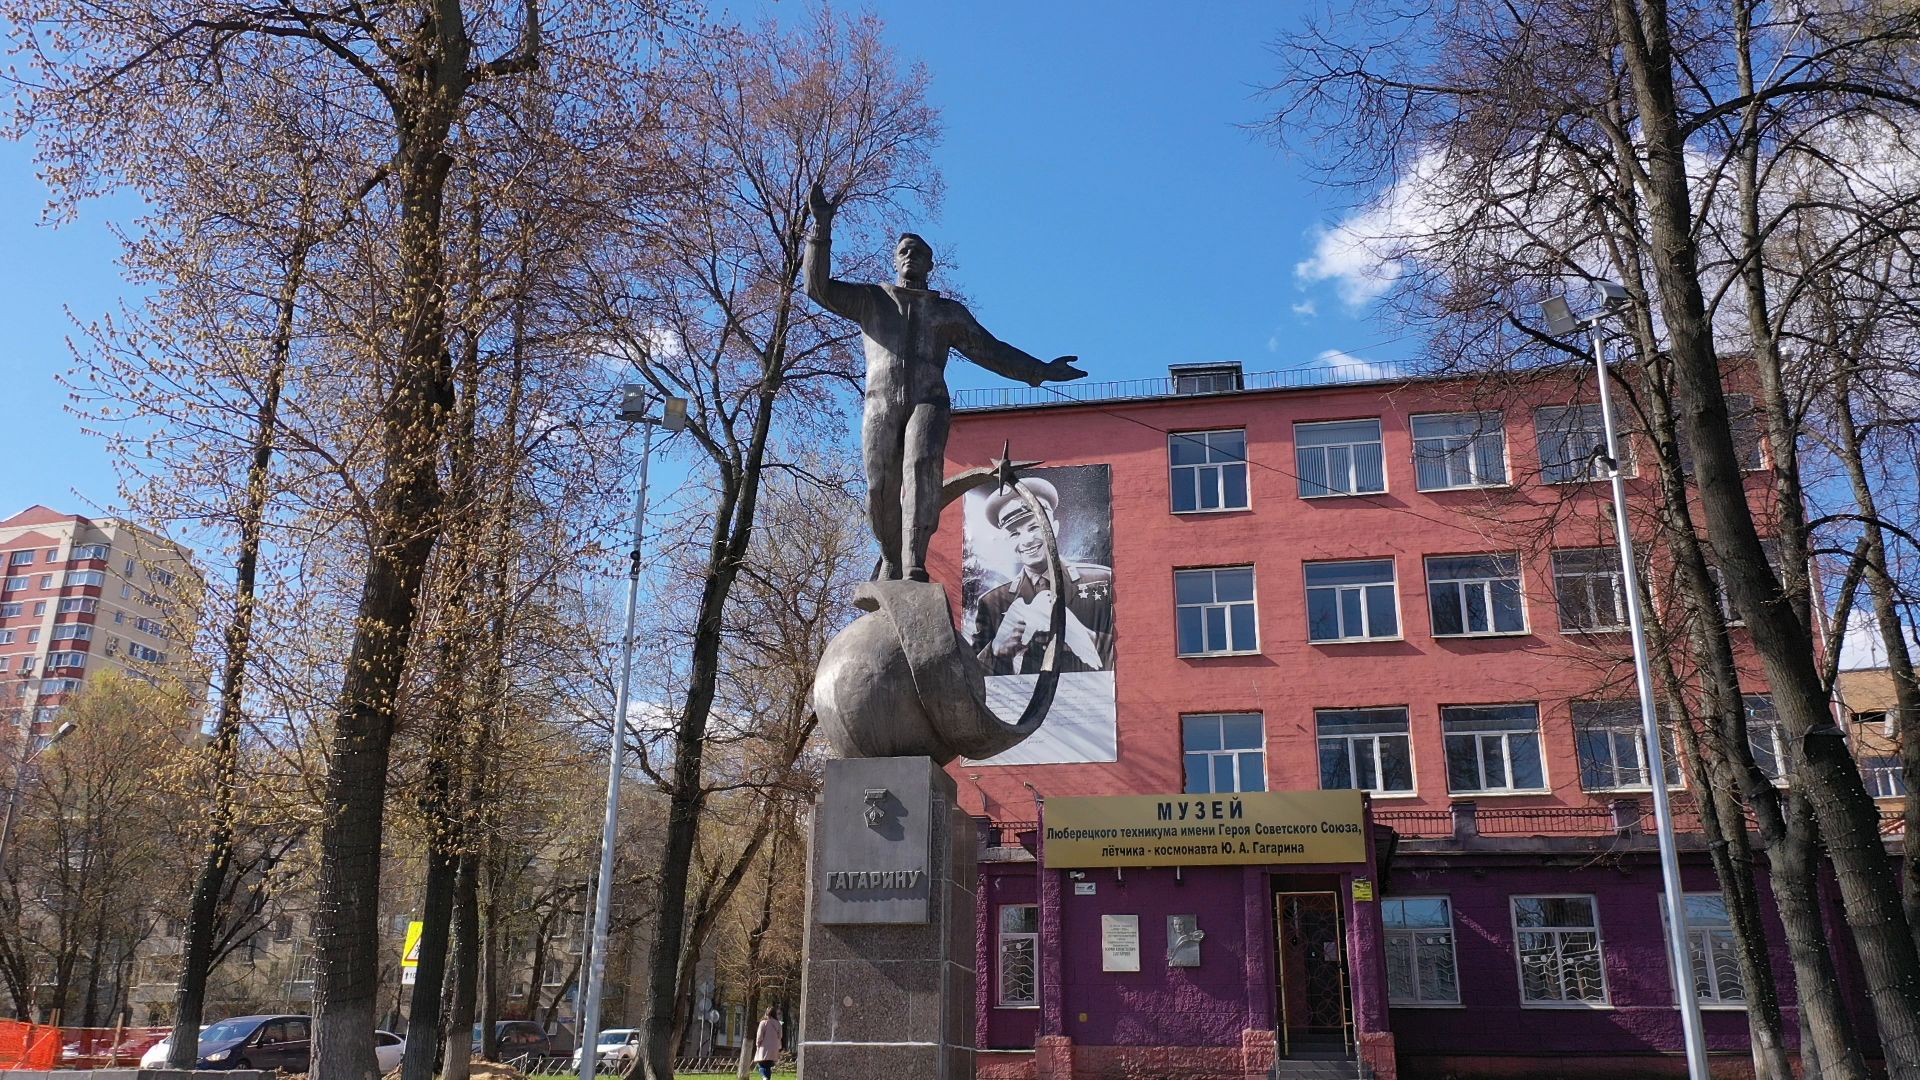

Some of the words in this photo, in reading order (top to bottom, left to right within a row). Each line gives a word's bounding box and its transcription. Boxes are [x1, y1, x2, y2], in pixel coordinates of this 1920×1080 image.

[1157, 797, 1243, 820] МУЗЕЙ
[1046, 827, 1117, 842] Люберецкого
[1120, 826, 1178, 840] техникума
[1180, 825, 1216, 837] имени
[1218, 824, 1251, 838] Героя
[1255, 822, 1317, 835] Советского
[1320, 821, 1362, 835] Союза,
[1101, 844, 1145, 857] лётчика
[1154, 843, 1218, 856] космонавта
[1221, 841, 1236, 854] Ю.
[1239, 841, 1250, 853] А.
[1252, 841, 1305, 856] Гагарина
[826, 870, 921, 890] ГАГАРИНУ
